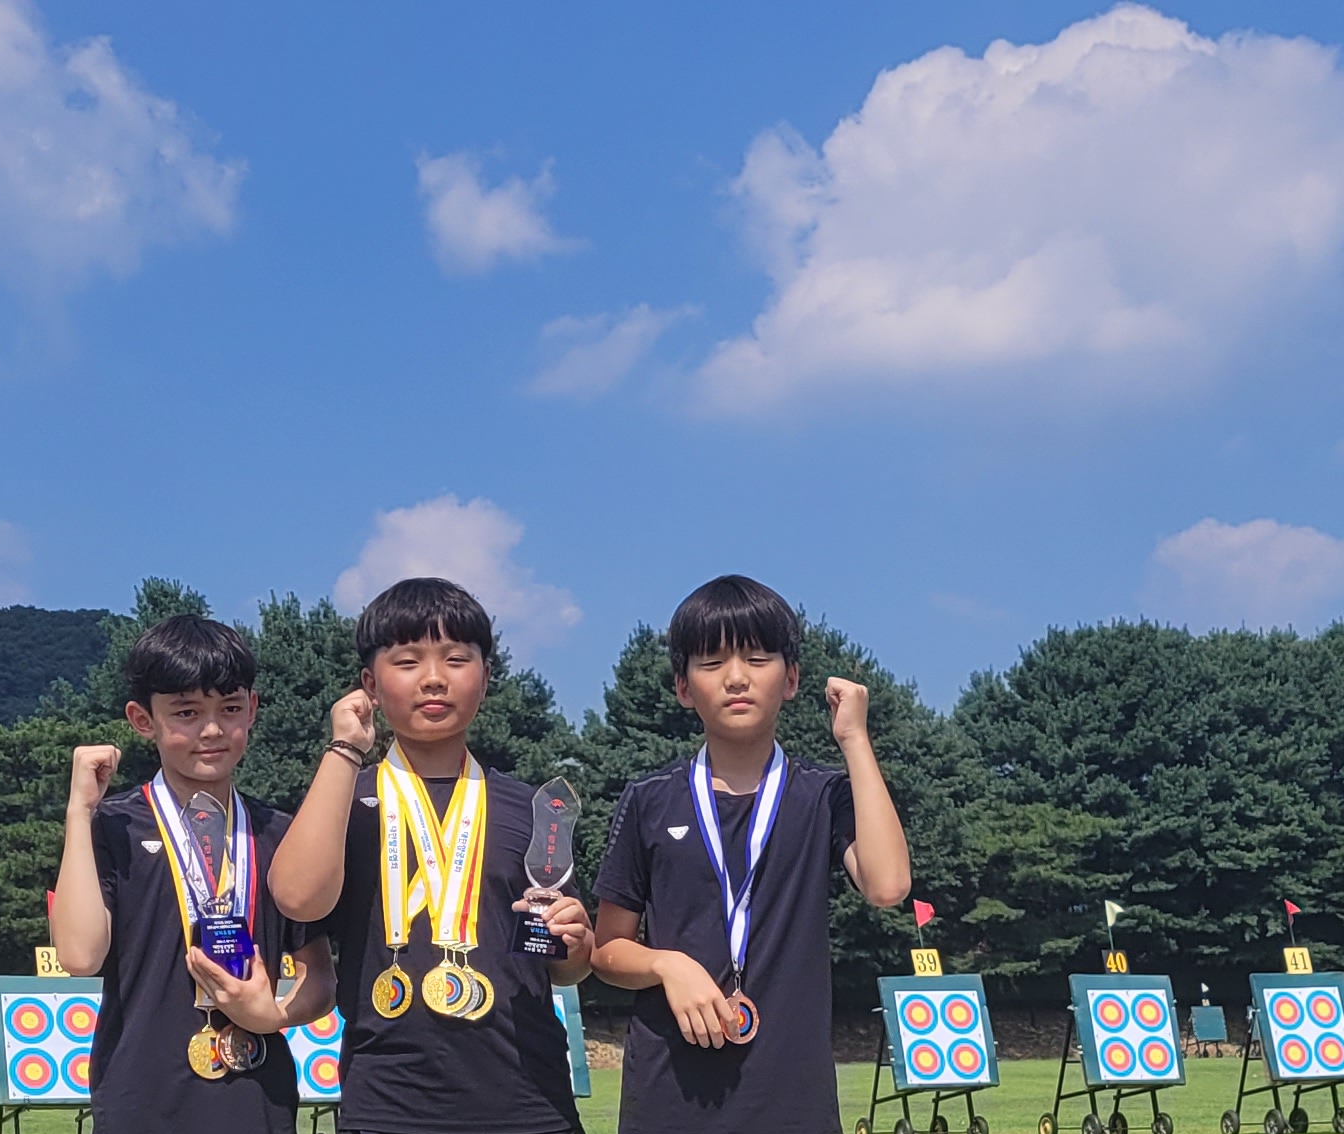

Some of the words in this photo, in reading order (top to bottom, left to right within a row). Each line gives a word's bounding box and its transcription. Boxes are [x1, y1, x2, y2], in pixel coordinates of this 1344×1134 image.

[916, 953, 937, 972] 39
[1106, 952, 1127, 973] 40
[1290, 951, 1308, 970] 41
